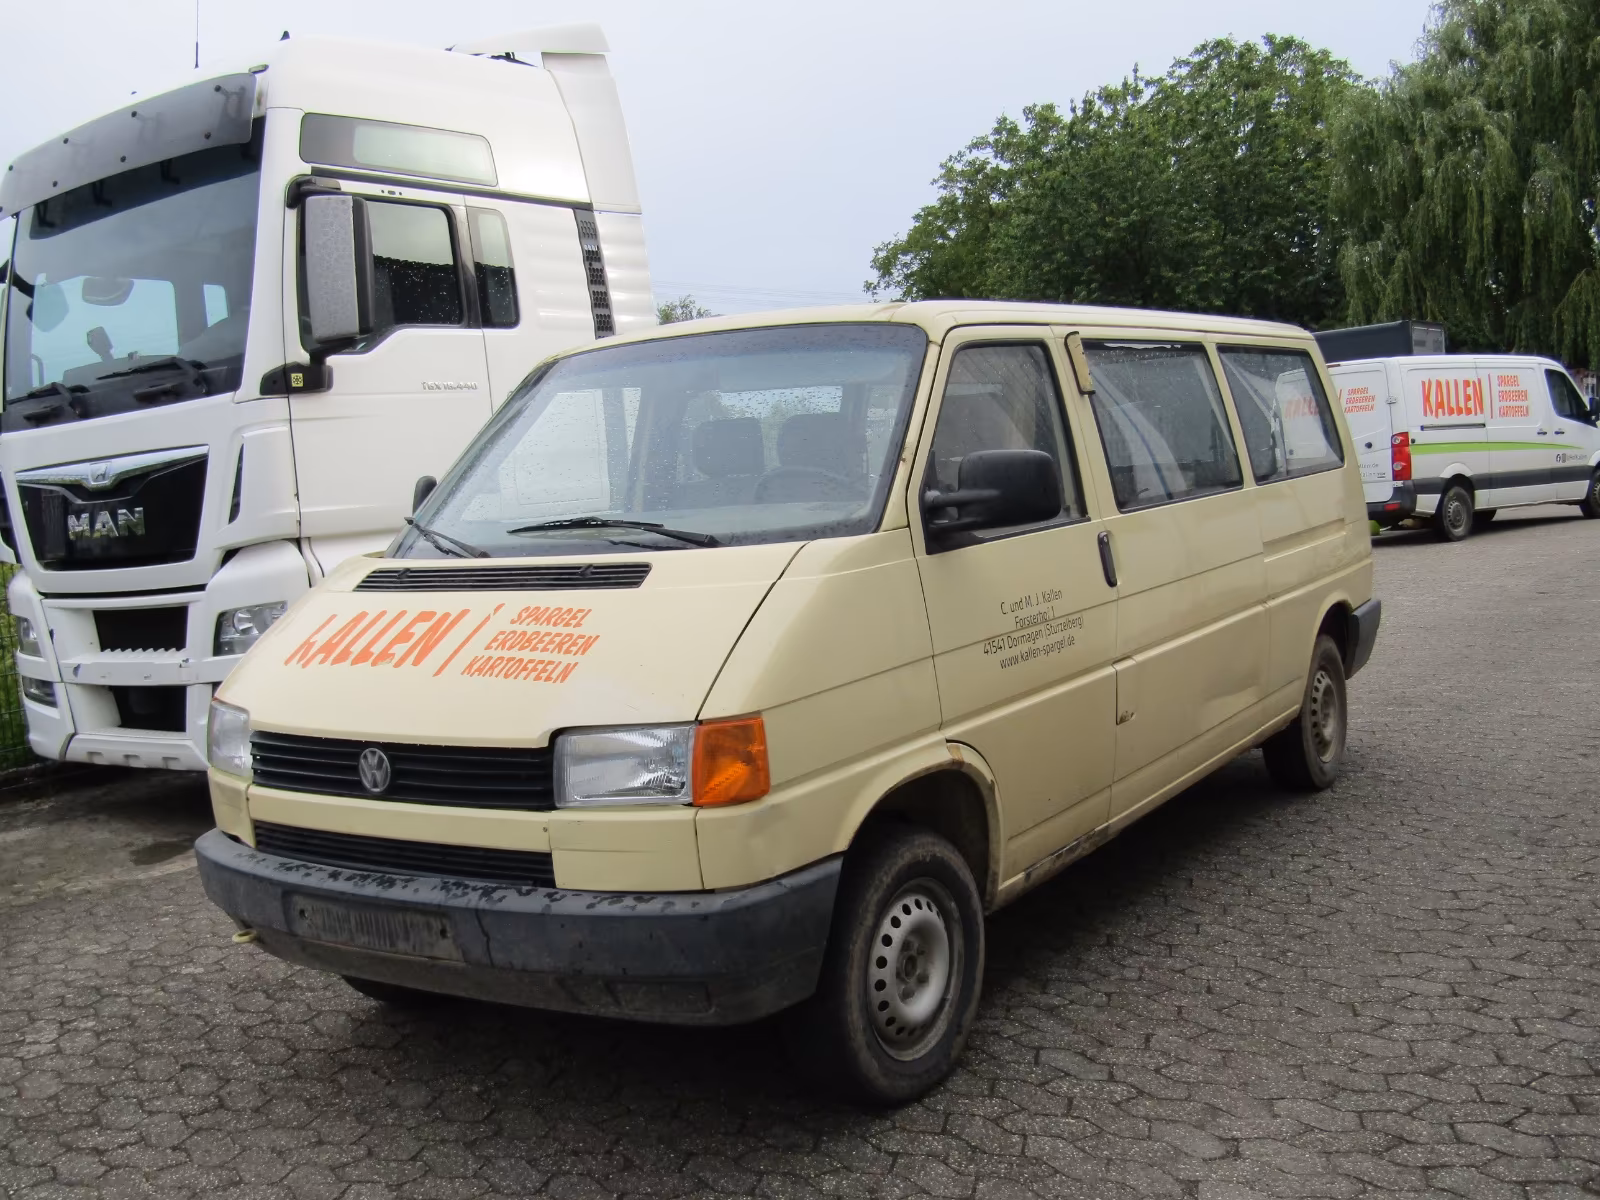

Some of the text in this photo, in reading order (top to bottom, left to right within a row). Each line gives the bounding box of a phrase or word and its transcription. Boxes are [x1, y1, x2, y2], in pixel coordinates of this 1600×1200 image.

[1347, 387, 1369, 396] SPARGEL
[1497, 375, 1520, 387] SPARGEL
[1345, 395, 1376, 405] ERDBEEREN
[1421, 378, 1484, 419] KALLEN
[1498, 389, 1528, 402] ERDBEEREN
[1498, 405, 1529, 417] KARTOFFELN
[67, 507, 146, 540] MAN
[1000, 589, 1063, 615] C. und M. J. Kallen
[510, 605, 593, 629] SPARGEL
[283, 609, 471, 669] KALLEN
[484, 630, 601, 657] ERDBEEREN
[983, 637, 1006, 656] 41541
[1006, 627, 1044, 649] Dormagen
[1000, 634, 1076, 670] www.kallen-spargel.de
[460, 654, 580, 685] KARTOFFELN
